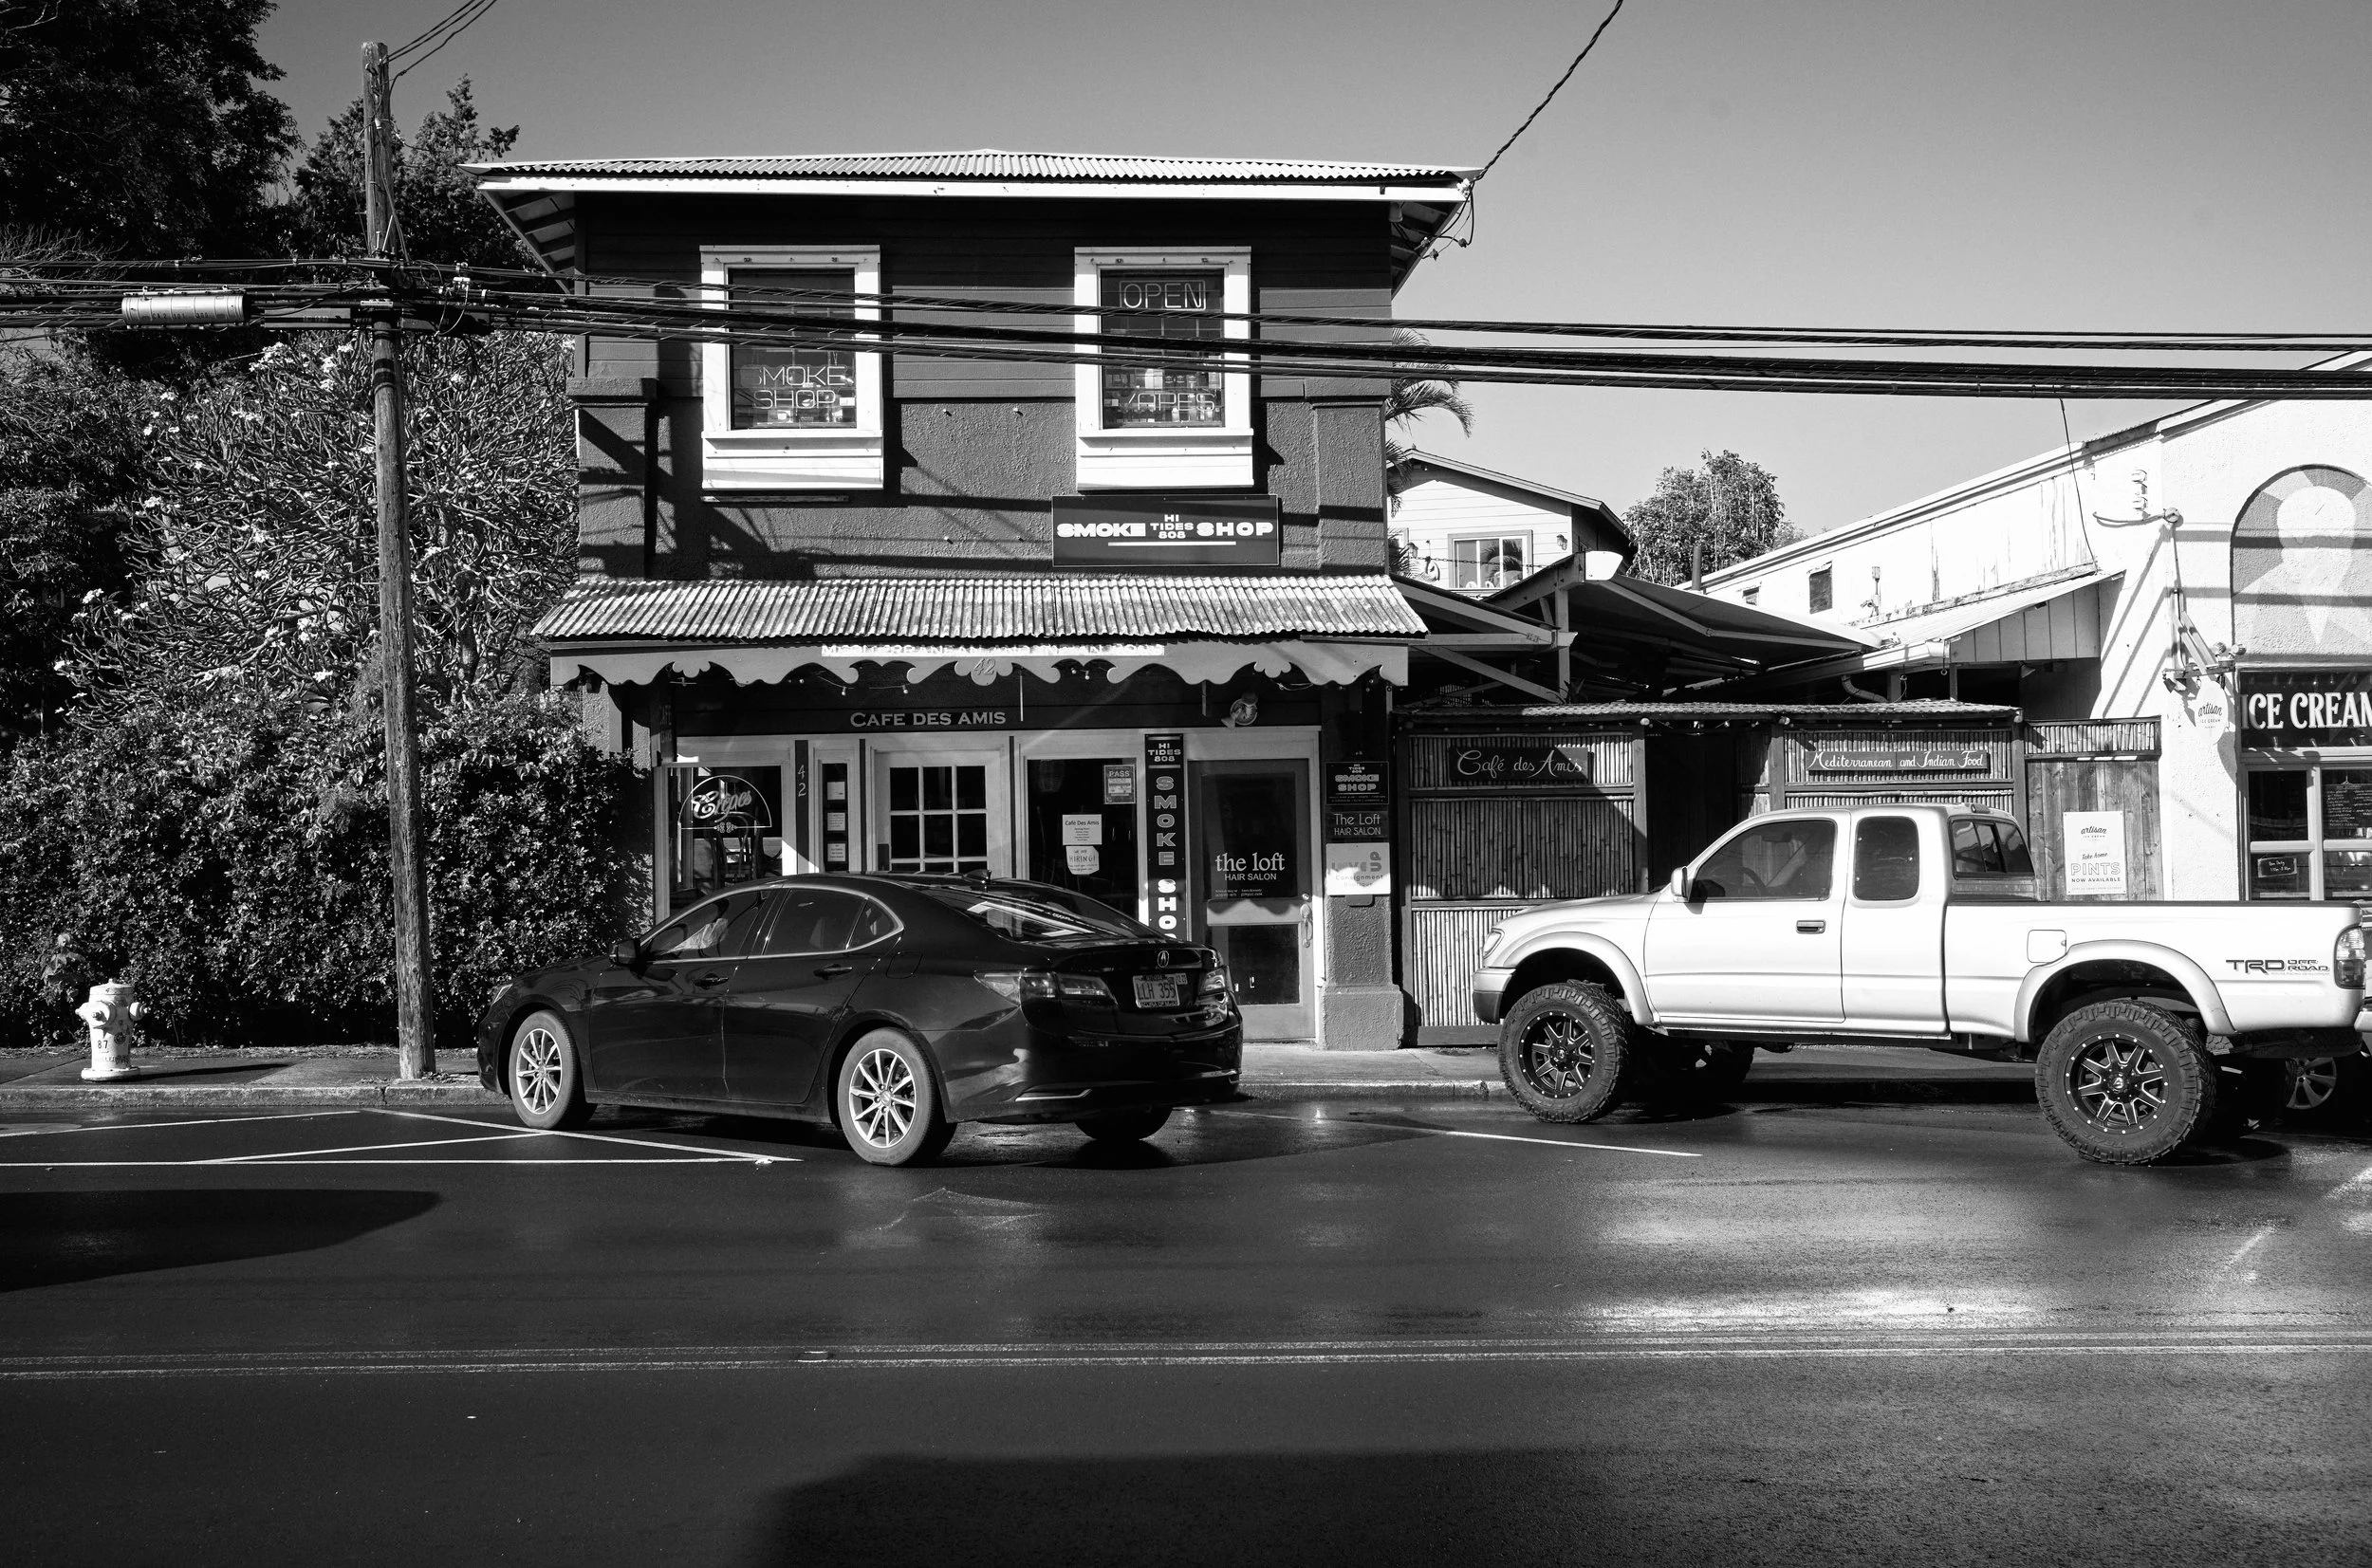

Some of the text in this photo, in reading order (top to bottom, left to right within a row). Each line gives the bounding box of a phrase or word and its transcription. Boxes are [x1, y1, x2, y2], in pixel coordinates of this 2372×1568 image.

[1123, 283, 1202, 308] OPEN
[753, 390, 836, 409] SHOP
[1056, 522, 1273, 538] SMOKE SHOP
[1150, 523, 1194, 531] TIDES
[1158, 530, 1186, 540] 808
[973, 658, 996, 675] 42
[2198, 702, 2223, 717] artisan
[2241, 692, 2285, 729] ICE
[850, 711, 1007, 728] CAFE DES AMIS
[1455, 747, 1582, 779] Café des Amis
[1807, 750, 1984, 770] Mediterranean and Indian Food
[1335, 774, 1380, 783] SMOKE
[1154, 776, 1177, 866] SMOKE
[1333, 813, 1381, 825] The Loft
[1334, 827, 1381, 836] HAIR SALON
[2081, 825, 2107, 835] artisan
[1214, 852, 1286, 872] the loft
[2070, 862, 2122, 876] PINTS
[1158, 878, 1177, 938] SHO
[2225, 959, 2286, 975] TRD
[1136, 982, 1176, 1000] LLH 355
[98, 1040, 108, 1049] 87
